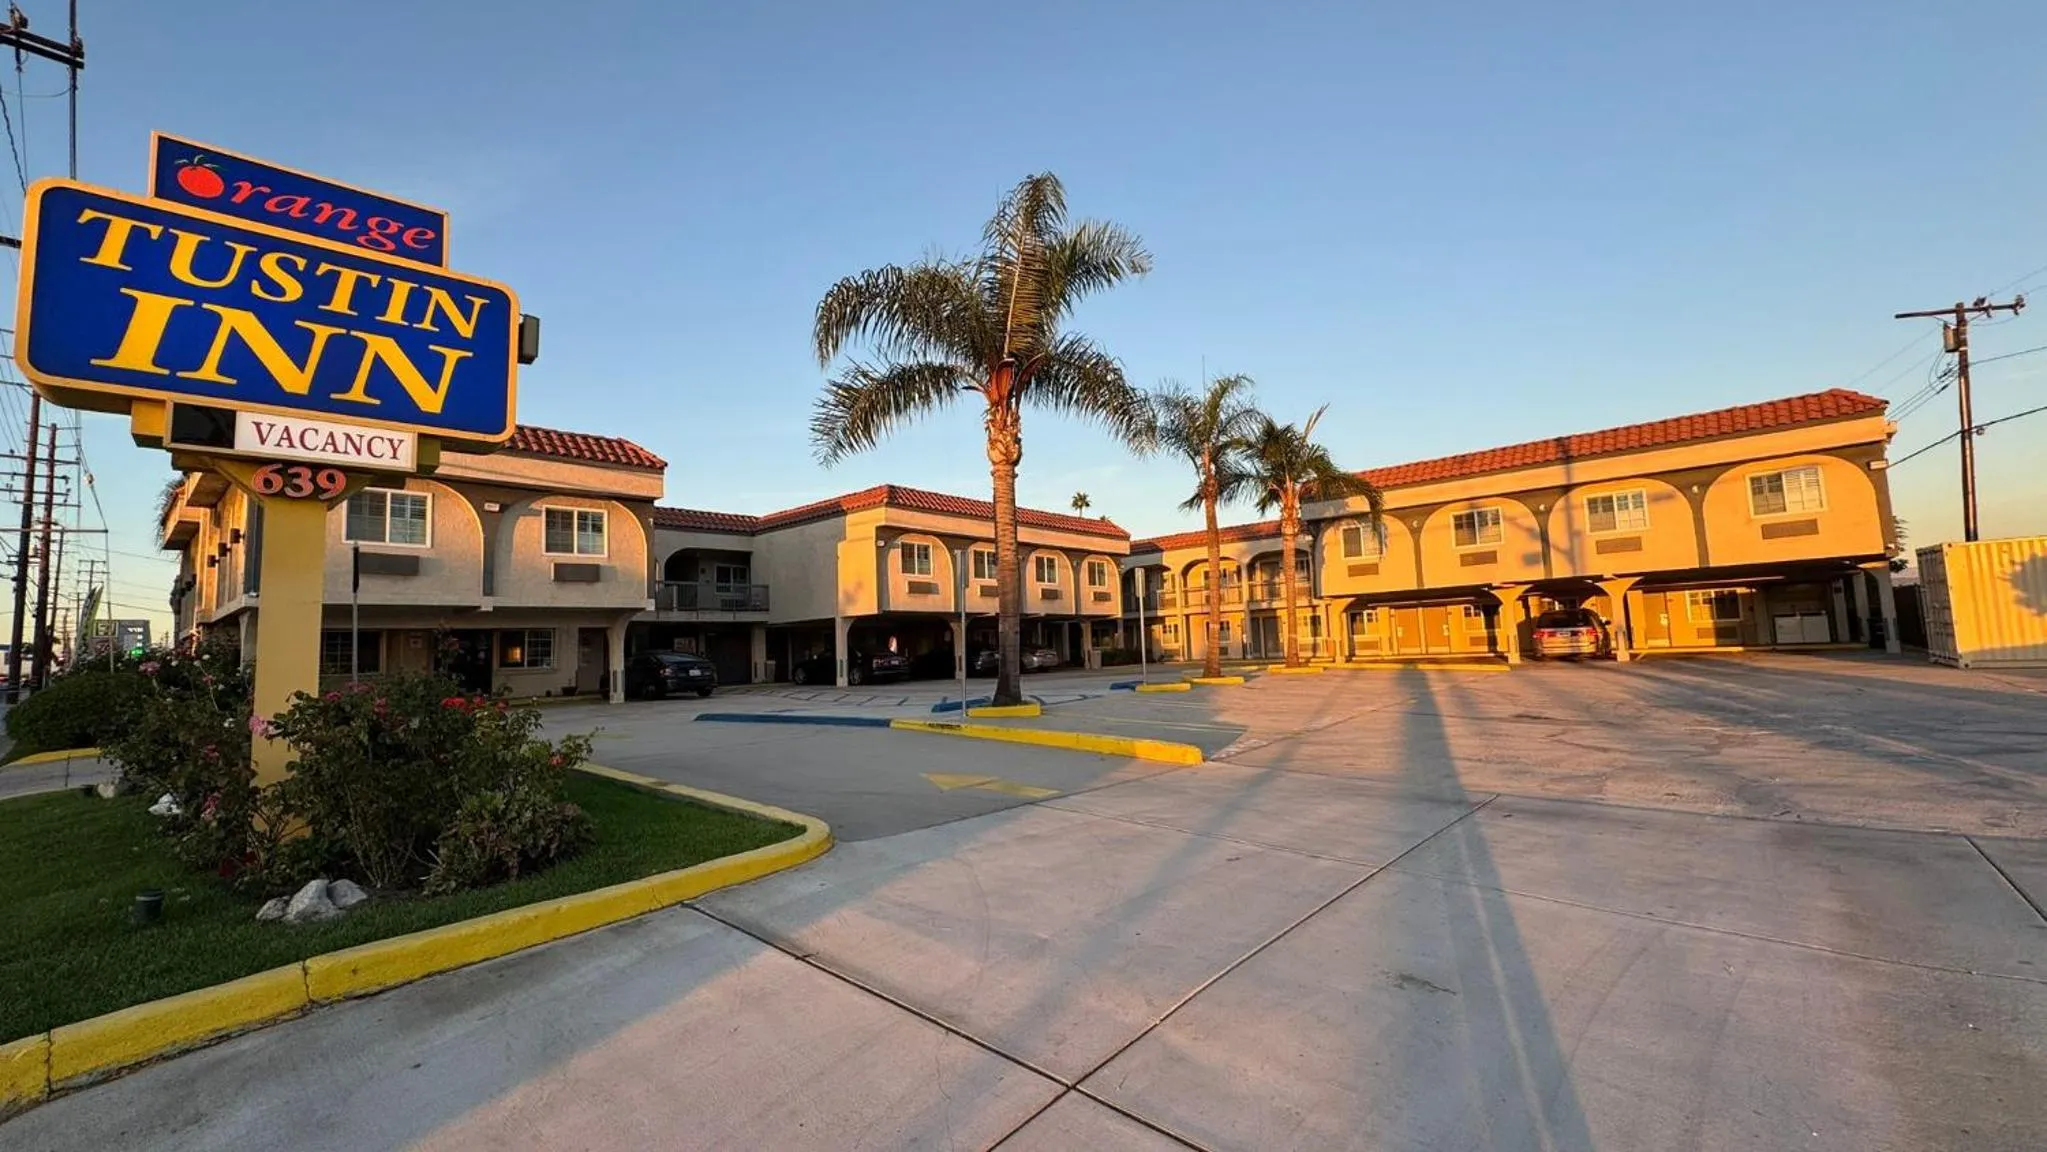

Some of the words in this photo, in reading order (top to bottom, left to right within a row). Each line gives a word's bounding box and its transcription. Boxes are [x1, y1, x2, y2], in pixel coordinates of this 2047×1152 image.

[77, 208, 490, 340] TUSTIN
[90, 288, 474, 415] INN
[252, 421, 405, 460] VACANCY
[252, 463, 347, 500] 639
